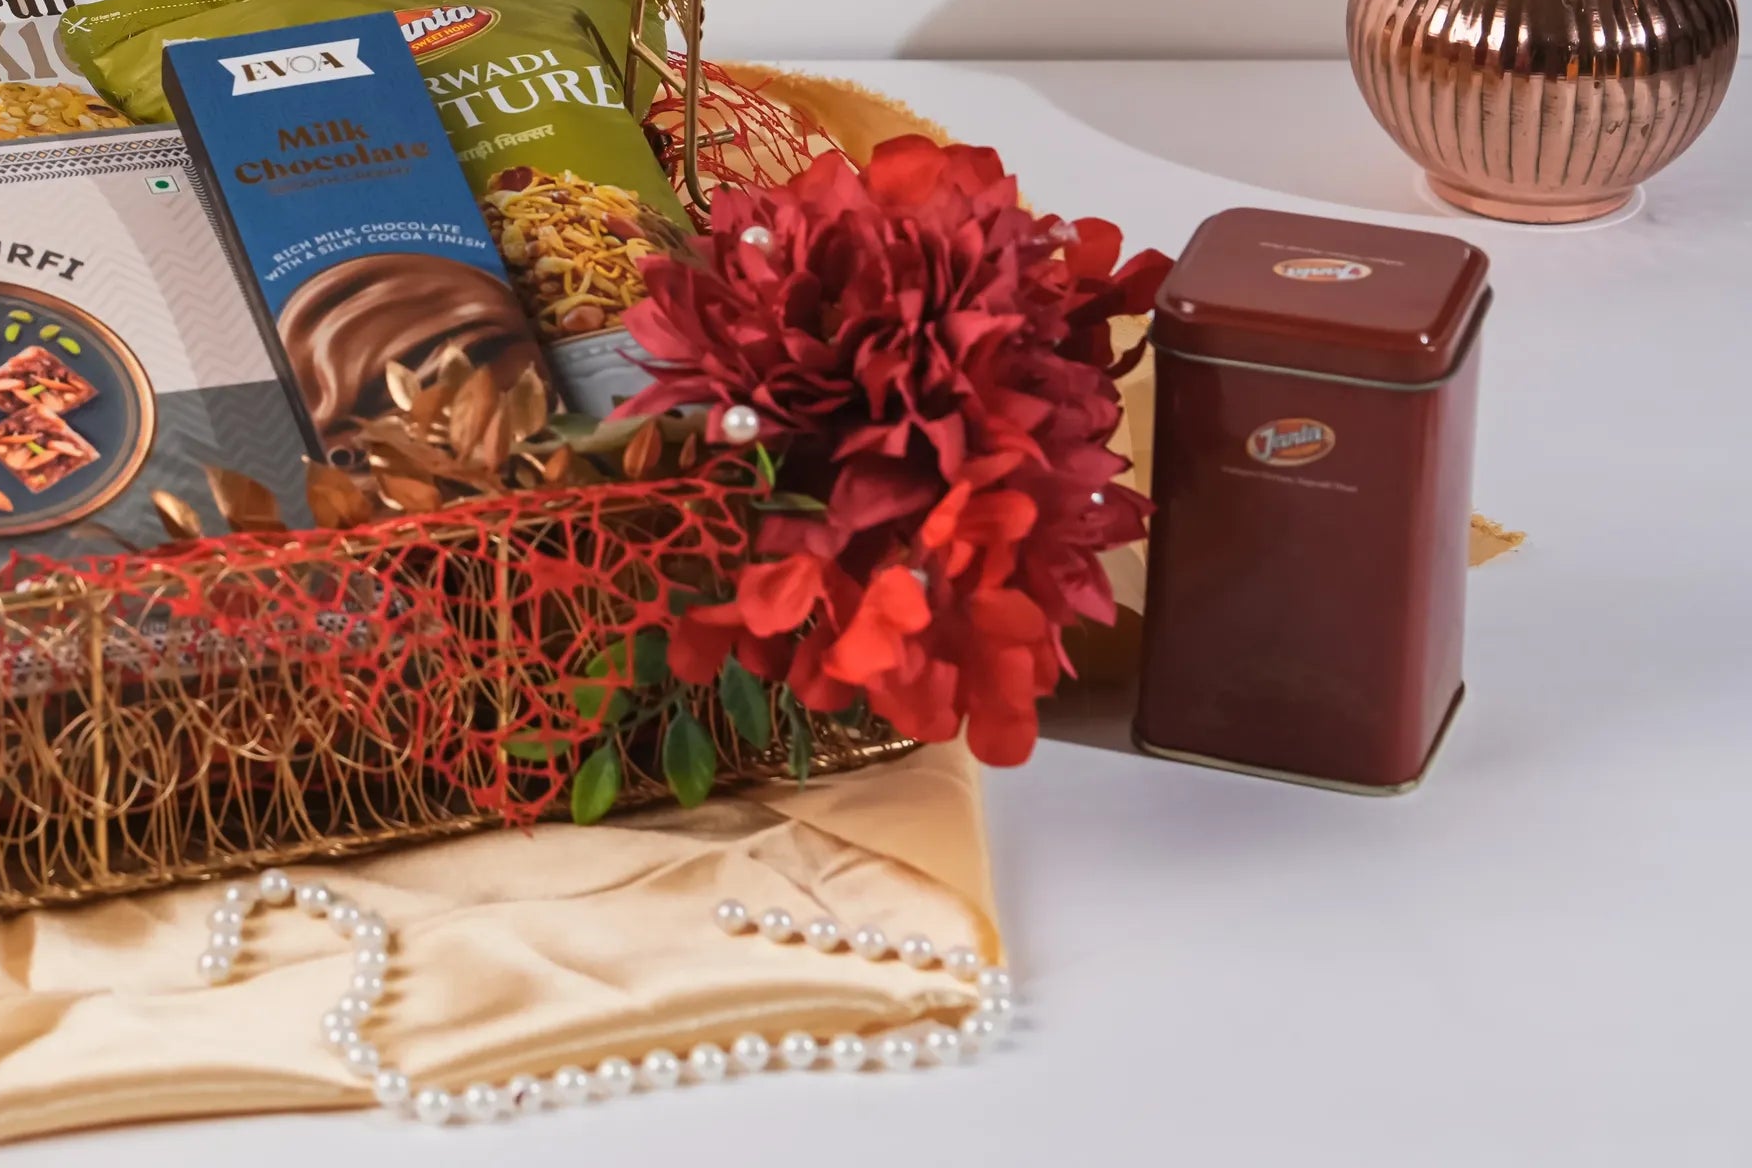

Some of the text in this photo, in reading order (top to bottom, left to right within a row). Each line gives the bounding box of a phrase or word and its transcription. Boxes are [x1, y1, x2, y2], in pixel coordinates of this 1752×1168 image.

[411, 31, 444, 50] SWEET
[444, 20, 476, 36] HOME
[241, 51, 345, 83] EVOA
[424, 49, 560, 95] RWADI
[438, 65, 625, 130] TURE
[277, 117, 371, 153] Milk
[234, 141, 430, 185] Chocolate
[264, 231, 487, 282] WITH A SILKY COCOA FINISH
[272, 221, 462, 263] RICH MILK CHOCOLATE
